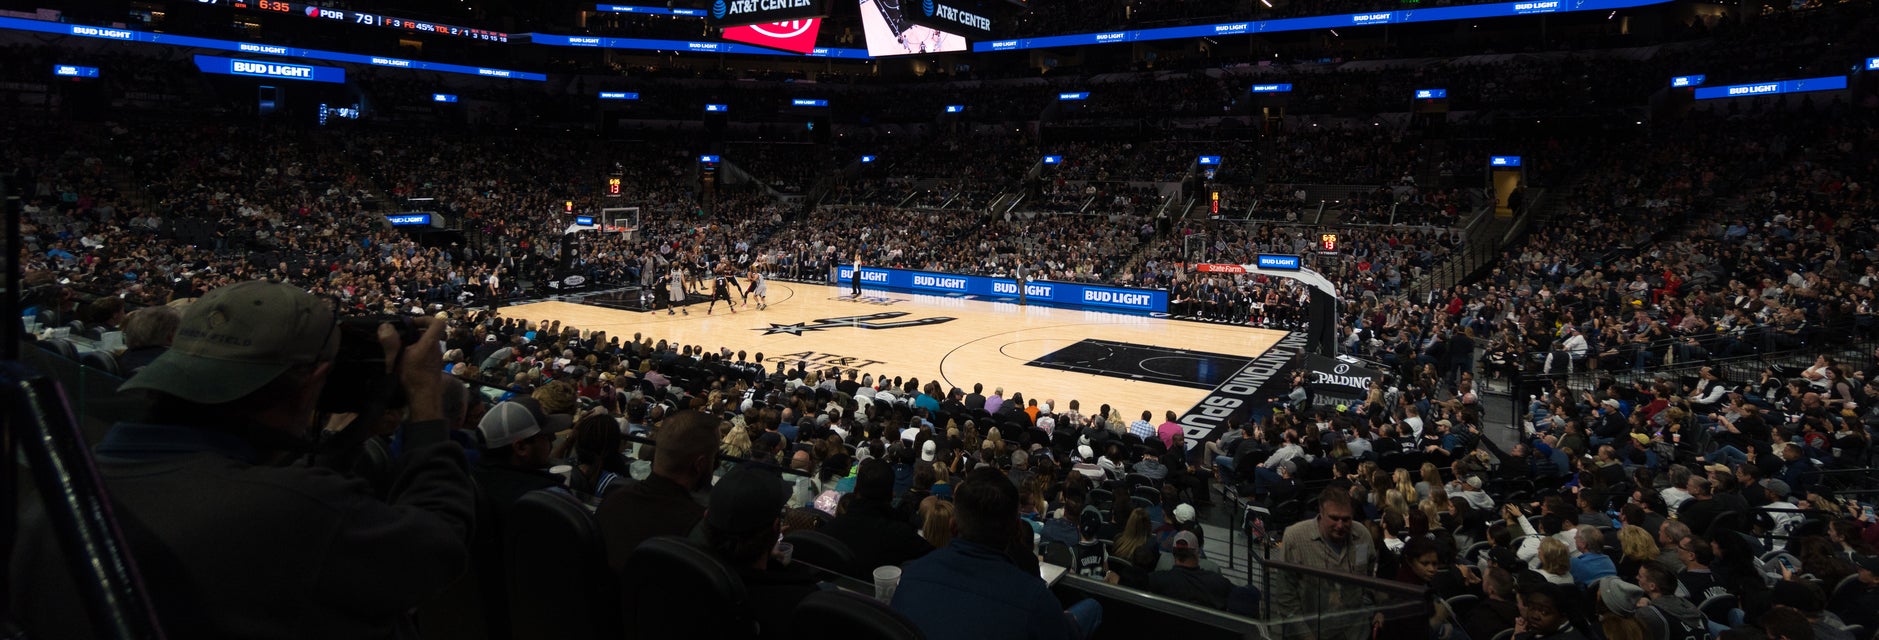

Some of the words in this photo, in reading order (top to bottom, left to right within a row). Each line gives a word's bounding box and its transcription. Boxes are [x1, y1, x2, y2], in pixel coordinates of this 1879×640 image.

[259, 0, 290, 12] 6:35
[729, 0, 759, 15] AT&T
[760, 0, 811, 11] CENTER
[1533, 1, 1558, 9] LIGHT
[320, 8, 345, 20] POR
[355, 13, 374, 25] 79
[936, 4, 958, 22] AT&T
[959, 9, 990, 31] CENTER
[1353, 14, 1371, 22] BUD
[1371, 13, 1390, 21] LIGHT
[73, 26, 98, 36] BUD
[98, 29, 131, 39] LIGHT
[394, 19, 401, 27] 3
[403, 21, 416, 29] FG
[416, 22, 435, 32] 45%
[435, 25, 450, 34] TOL
[240, 43, 260, 52] BUD
[261, 45, 287, 54] LIGHT
[234, 61, 267, 74] BUD
[268, 63, 312, 77] LIGHT
[389, 59, 410, 67] LIGHT
[1729, 85, 1749, 94] BUD
[1750, 84, 1777, 93] LIGHT
[610, 185, 619, 194] 13
[404, 216, 424, 224] LIGHT
[1325, 241, 1334, 250] 13
[861, 271, 888, 282] LIGHT
[914, 275, 935, 285] BUD
[935, 277, 966, 289] LIGHT
[994, 282, 1017, 294] BUD
[1085, 290, 1112, 302] BUD
[1112, 292, 1150, 306] LIGHT
[1275, 331, 1309, 349] SAN
[779, 351, 889, 369] AT&T
[1220, 348, 1297, 396] ANTONIO
